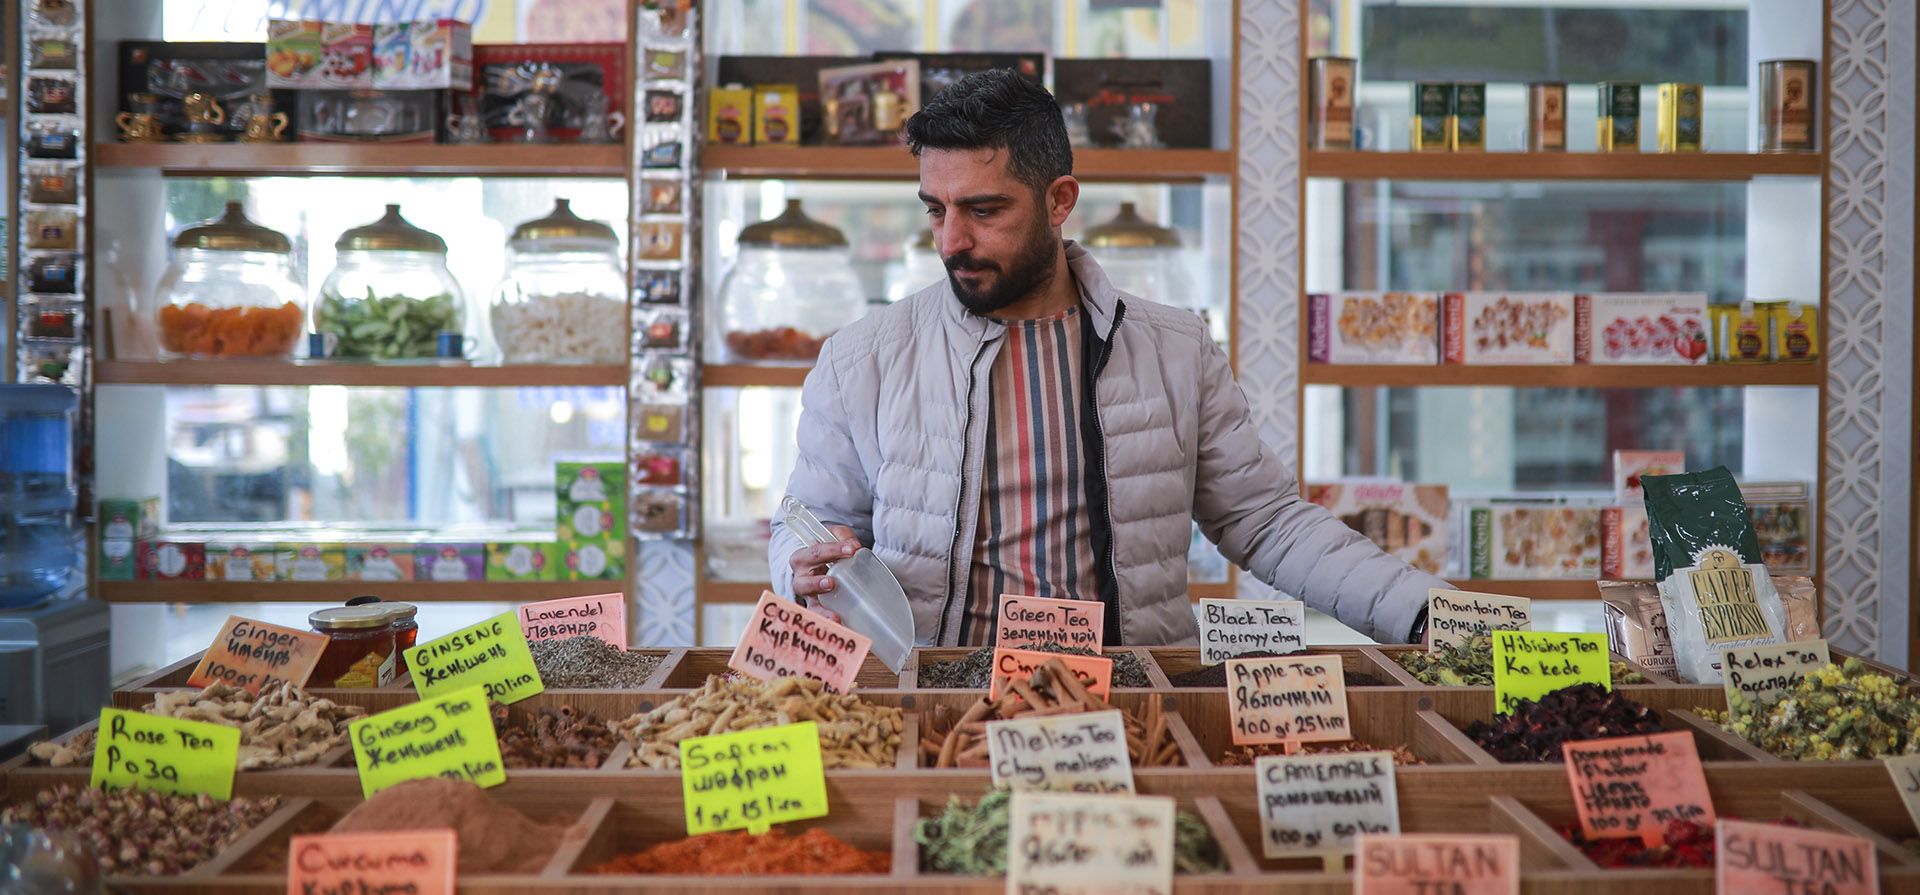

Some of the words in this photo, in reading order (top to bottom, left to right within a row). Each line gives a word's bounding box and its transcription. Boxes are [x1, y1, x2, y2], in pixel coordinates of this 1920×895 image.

[1004, 600, 1056, 623] Green
[1057, 606, 1089, 627] Tea
[1206, 604, 1257, 626] Black
[1255, 607, 1294, 626] Tea
[1433, 596, 1502, 617] Mountain
[1501, 604, 1528, 621] Tea
[1701, 602, 1768, 640] ESPRESSO
[232, 621, 300, 649] Ginger
[415, 622, 502, 667] GINSENG
[1568, 637, 1599, 653] Tea
[1726, 651, 1785, 670] Relax
[1234, 663, 1287, 689] Apple
[1288, 663, 1326, 678] Tea
[111, 714, 168, 745] Rose
[173, 729, 214, 751] Tea
[1237, 717, 1272, 736] 100
[687, 742, 793, 770] Safran
[695, 806, 704, 826] 1
[1271, 829, 1301, 845] 100
[1366, 841, 1501, 881] SULTAN
[1726, 834, 1865, 886] SULTAN
